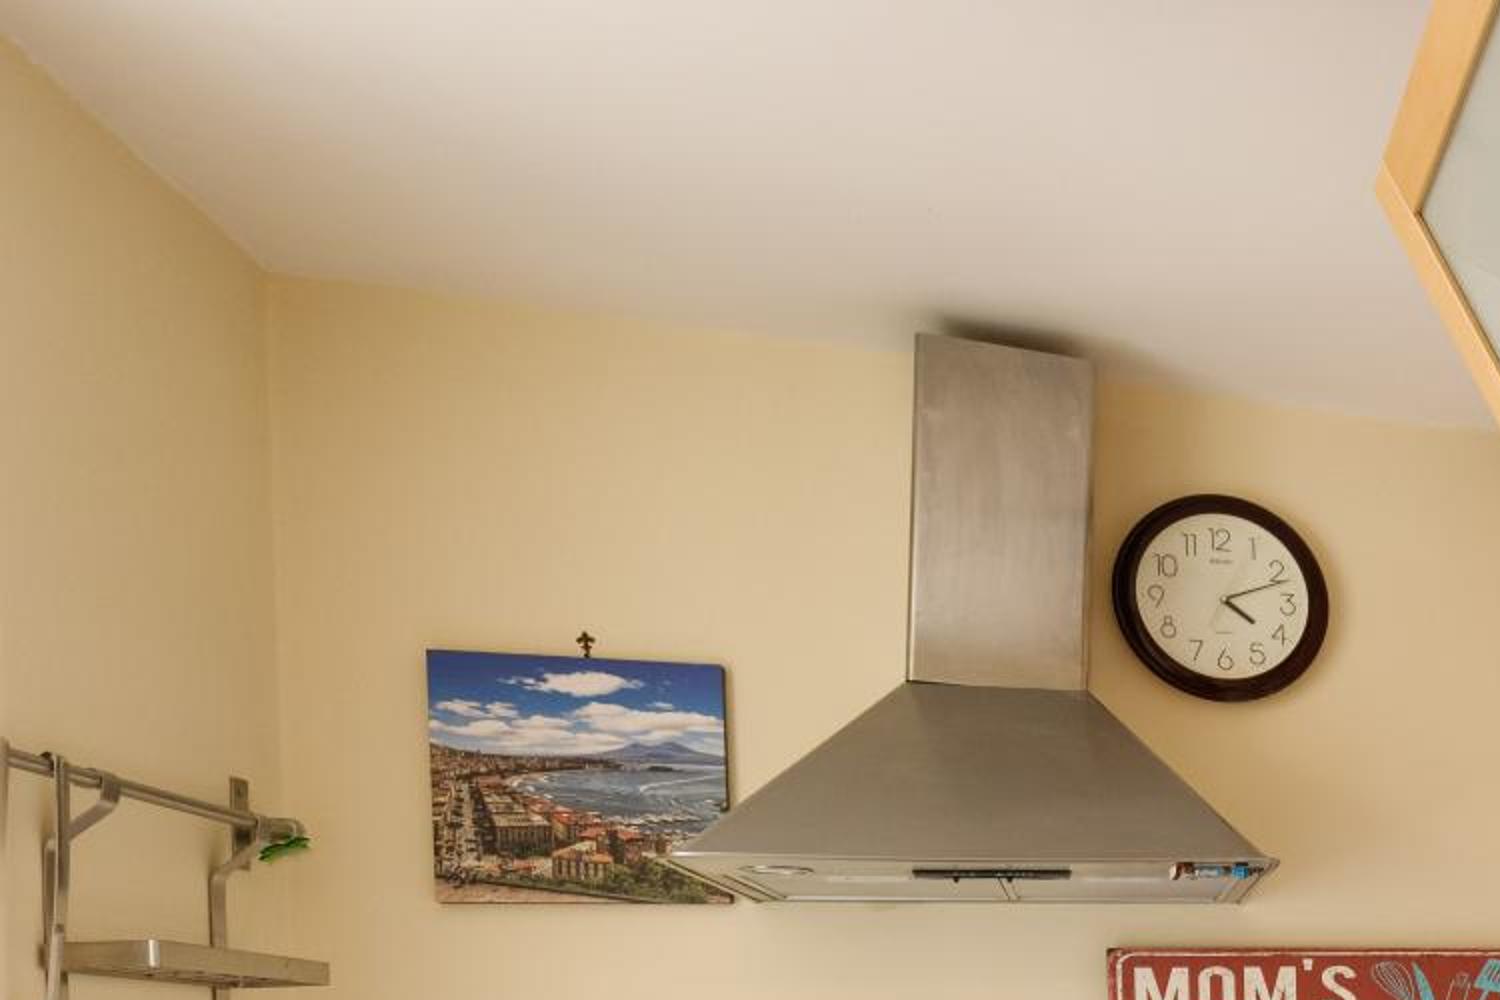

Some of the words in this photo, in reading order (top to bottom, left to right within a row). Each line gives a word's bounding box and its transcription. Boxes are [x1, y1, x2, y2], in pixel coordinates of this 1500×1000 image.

[1183, 533, 1198, 558] 11
[1208, 527, 1233, 553] 12
[1248, 537, 1257, 561] 1
[1154, 553, 1179, 578] 10
[1268, 559, 1288, 583] 2
[1147, 584, 1165, 609] 9
[1279, 593, 1297, 617] 3
[1159, 615, 1177, 639] 8
[1271, 623, 1289, 647] 4
[1189, 639, 1204, 662] 7
[1217, 646, 1235, 671] 6
[1248, 642, 1266, 666] 5
